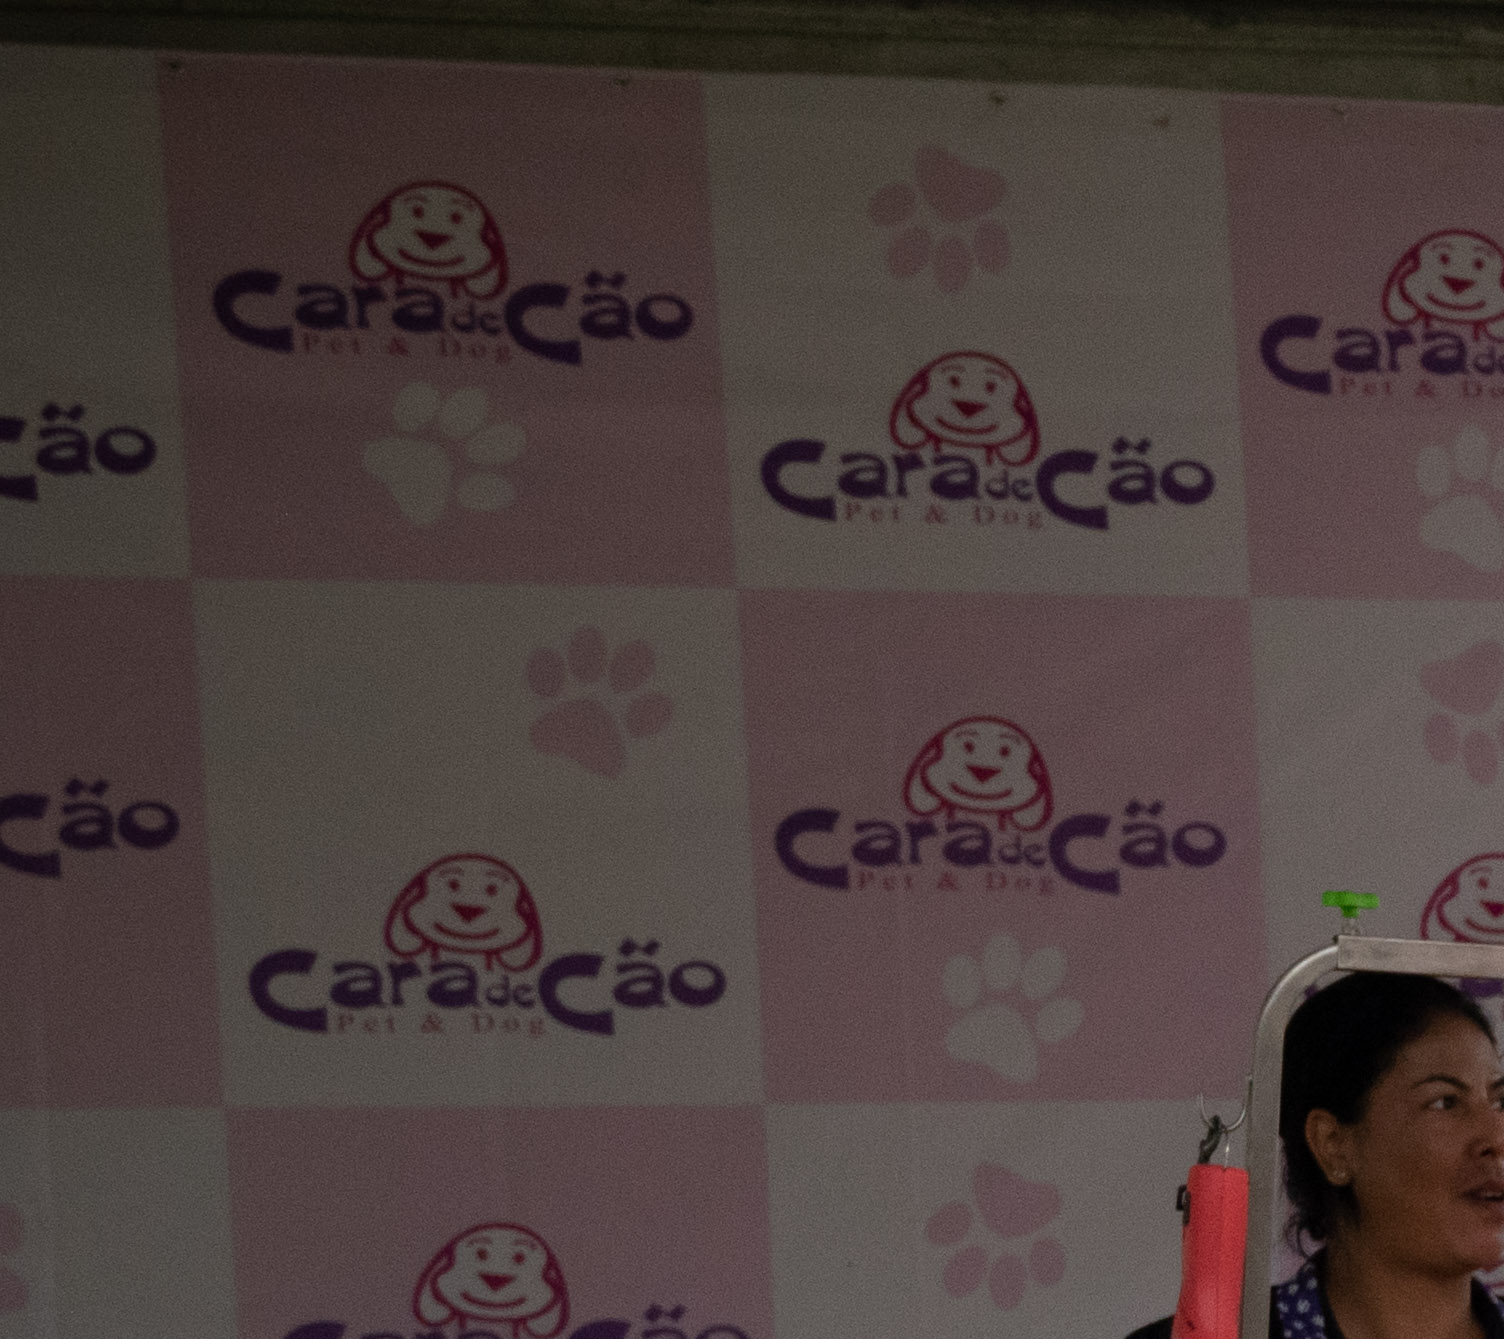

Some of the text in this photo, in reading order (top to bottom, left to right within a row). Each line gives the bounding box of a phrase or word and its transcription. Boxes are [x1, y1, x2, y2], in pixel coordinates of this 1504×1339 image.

[212, 267, 447, 354] Cara
[450, 301, 504, 337] de
[301, 334, 363, 358] Pet
[436, 340, 514, 368] Dog
[1259, 314, 1469, 395] Cara
[1338, 376, 1394, 399] Pet
[759, 438, 981, 521] Cara
[985, 468, 1036, 503] de
[843, 502, 902, 525] Pet
[972, 506, 1045, 533] Dog
[774, 807, 994, 890] Cara
[997, 834, 1047, 868] de
[856, 870, 915, 892] Pet
[984, 871, 1057, 897] Dog
[248, 948, 480, 1033] Cara
[484, 974, 537, 1009] de
[335, 1012, 397, 1034] Pet
[470, 1013, 548, 1039] Dog
